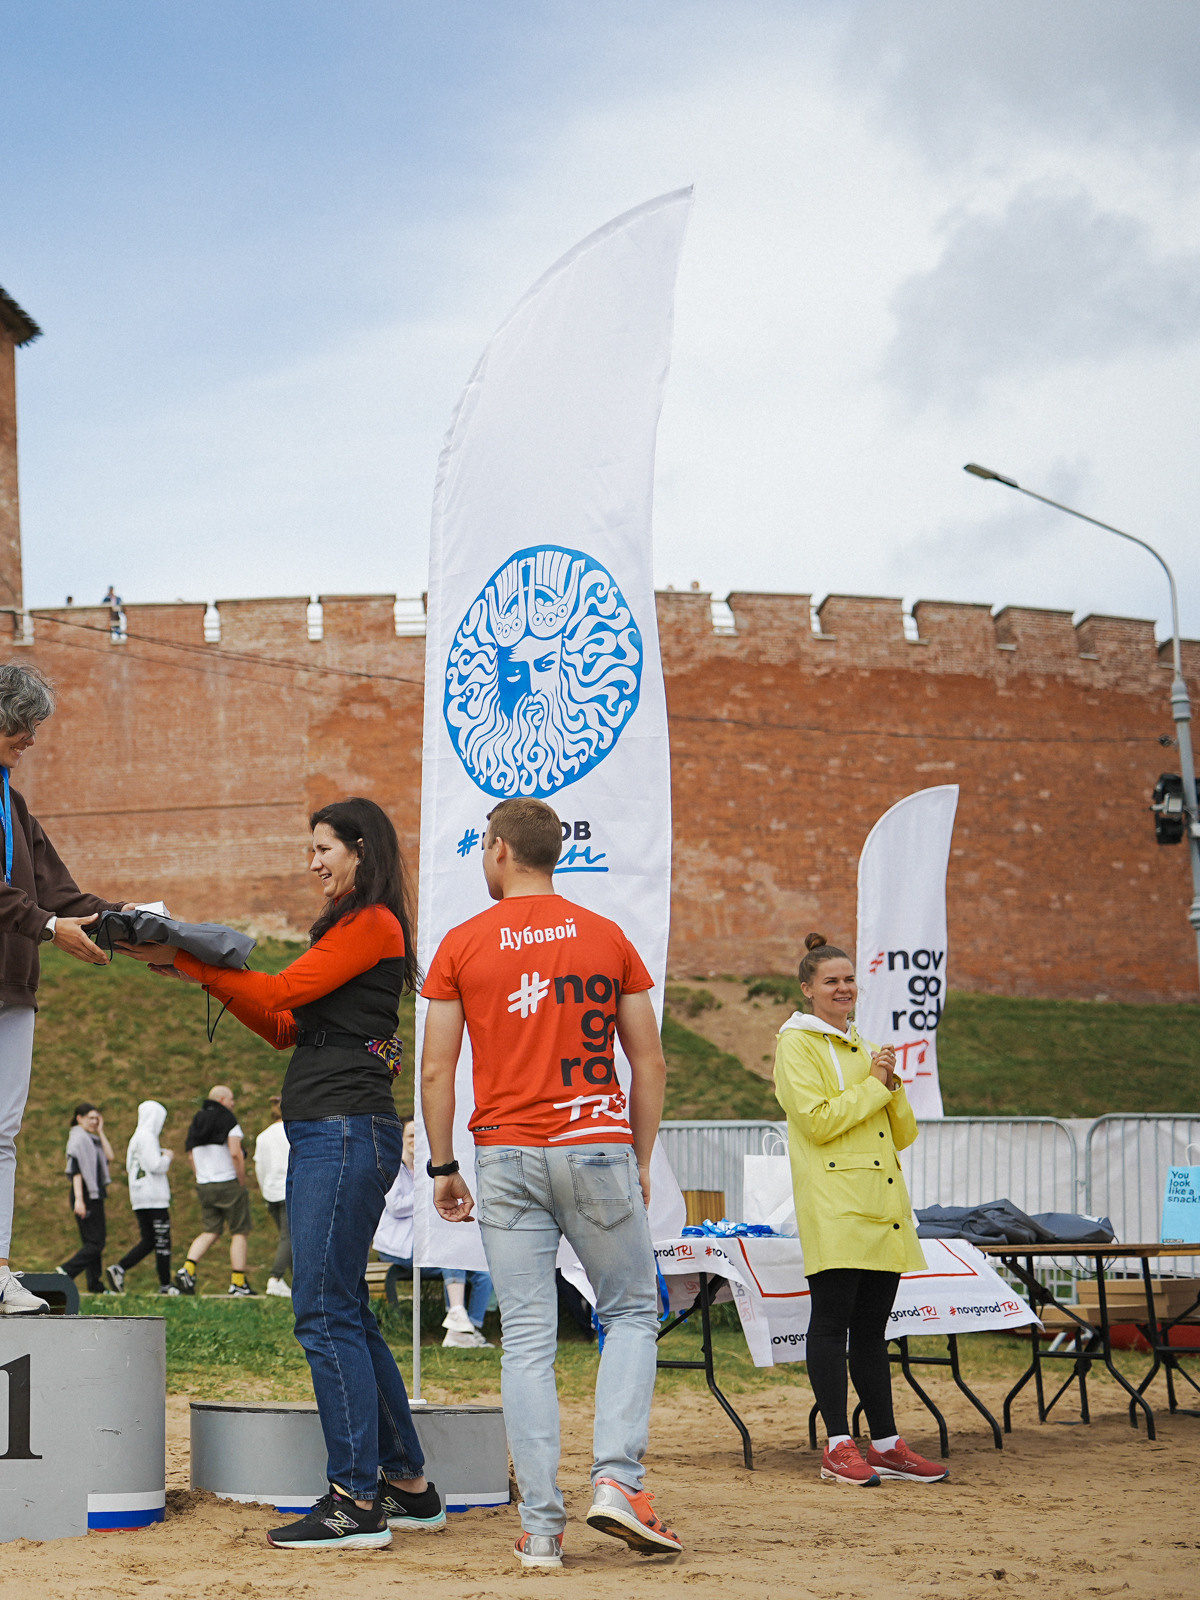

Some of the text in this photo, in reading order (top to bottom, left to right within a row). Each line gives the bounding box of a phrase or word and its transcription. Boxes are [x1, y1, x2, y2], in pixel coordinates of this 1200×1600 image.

[499, 917, 578, 951] Дубовой
[1171, 1170, 1190, 1179] You
[1170, 1179, 1191, 1187] look
[1168, 1187, 1187, 1195] like
